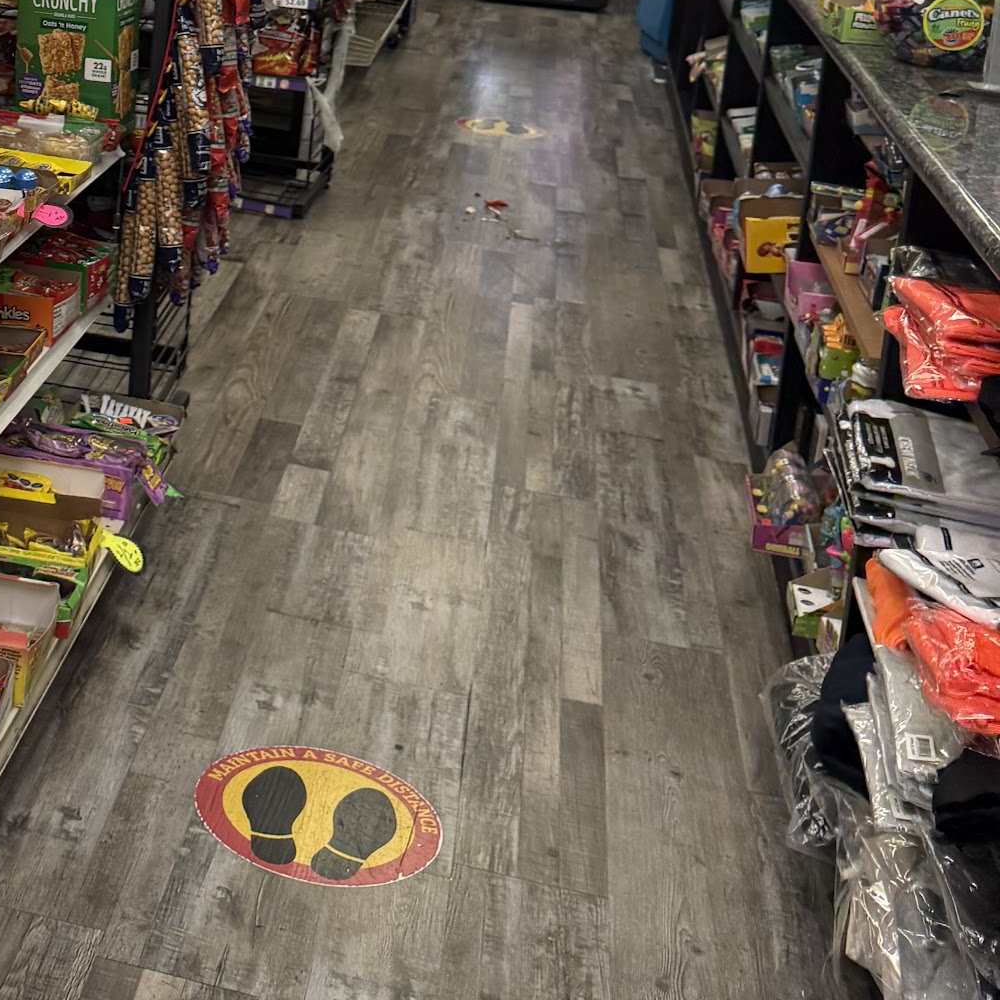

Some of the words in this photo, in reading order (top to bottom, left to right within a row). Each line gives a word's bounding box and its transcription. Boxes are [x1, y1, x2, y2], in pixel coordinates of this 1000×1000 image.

[42, 20, 57, 28] Oats
[66, 22, 87, 32] Honey
[208, 748, 296, 782] MAINTAIN
[303, 750, 318, 760] A
[324, 753, 375, 776] SAFE
[377, 774, 438, 835] DISTANCE
